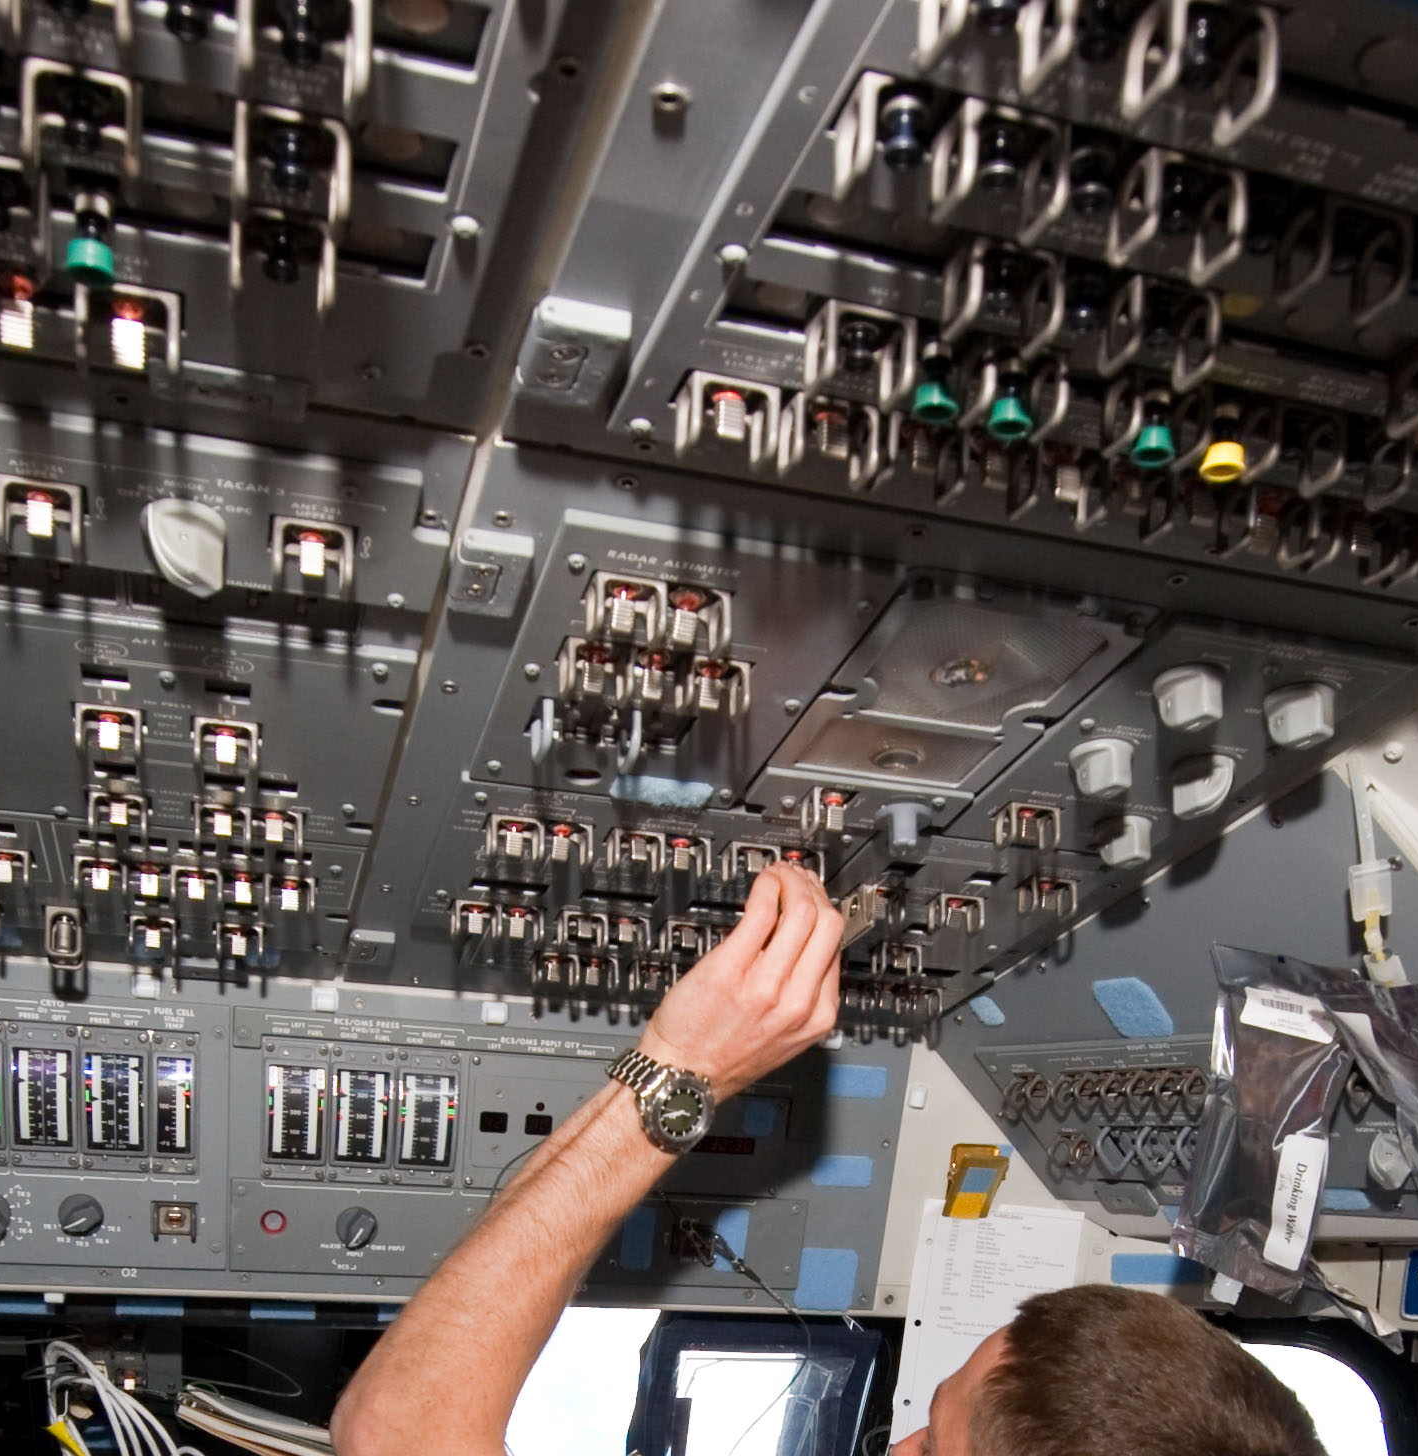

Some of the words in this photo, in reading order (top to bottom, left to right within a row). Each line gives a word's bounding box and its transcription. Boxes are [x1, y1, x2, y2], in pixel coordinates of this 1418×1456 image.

[215, 478, 270, 494] TACAN
[607, 548, 658, 565] RADAR
[663, 559, 741, 577] ALTIMETER
[39, 998, 65, 1008] CRYO
[153, 1006, 174, 1015] FUEL
[176, 1008, 195, 1017] CELL
[374, 1019, 400, 1030] PRESS
[1286, 1162, 1308, 1211] Drinking
[1284, 1214, 1298, 1244] Water
